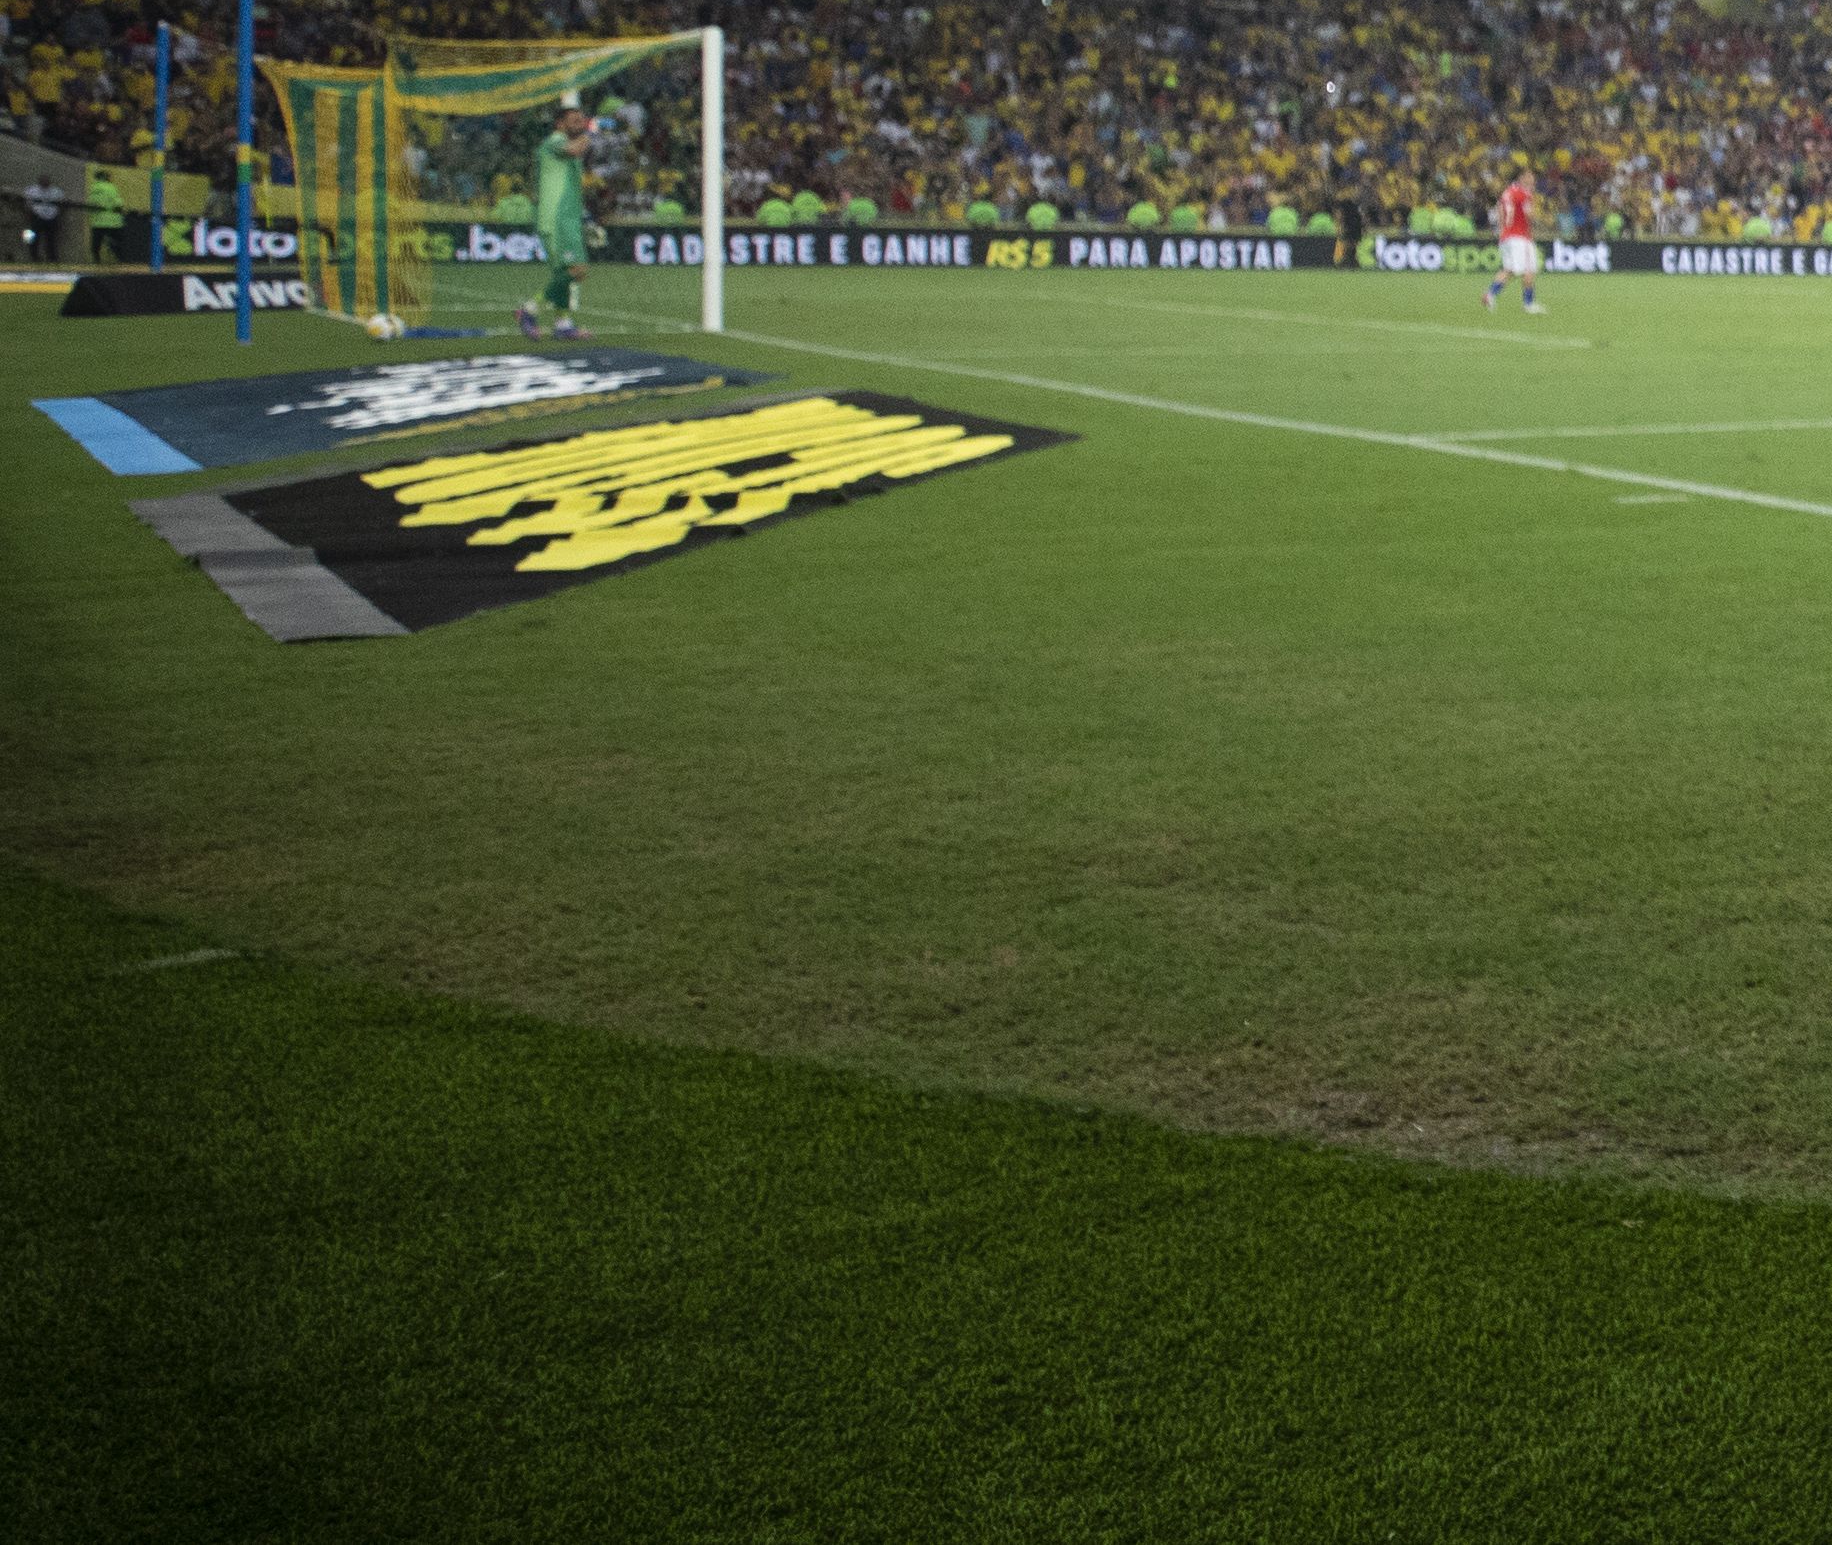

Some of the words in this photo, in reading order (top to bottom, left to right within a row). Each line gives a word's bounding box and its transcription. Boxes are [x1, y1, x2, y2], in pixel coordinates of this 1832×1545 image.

[633, 233, 816, 266] CADSTRE
[829, 234, 848, 265] E
[862, 234, 971, 266] GANHE
[1069, 236, 1148, 269] PARA
[1159, 238, 1292, 270] APOSTAR
[1662, 246, 1783, 275] CADASTRE
